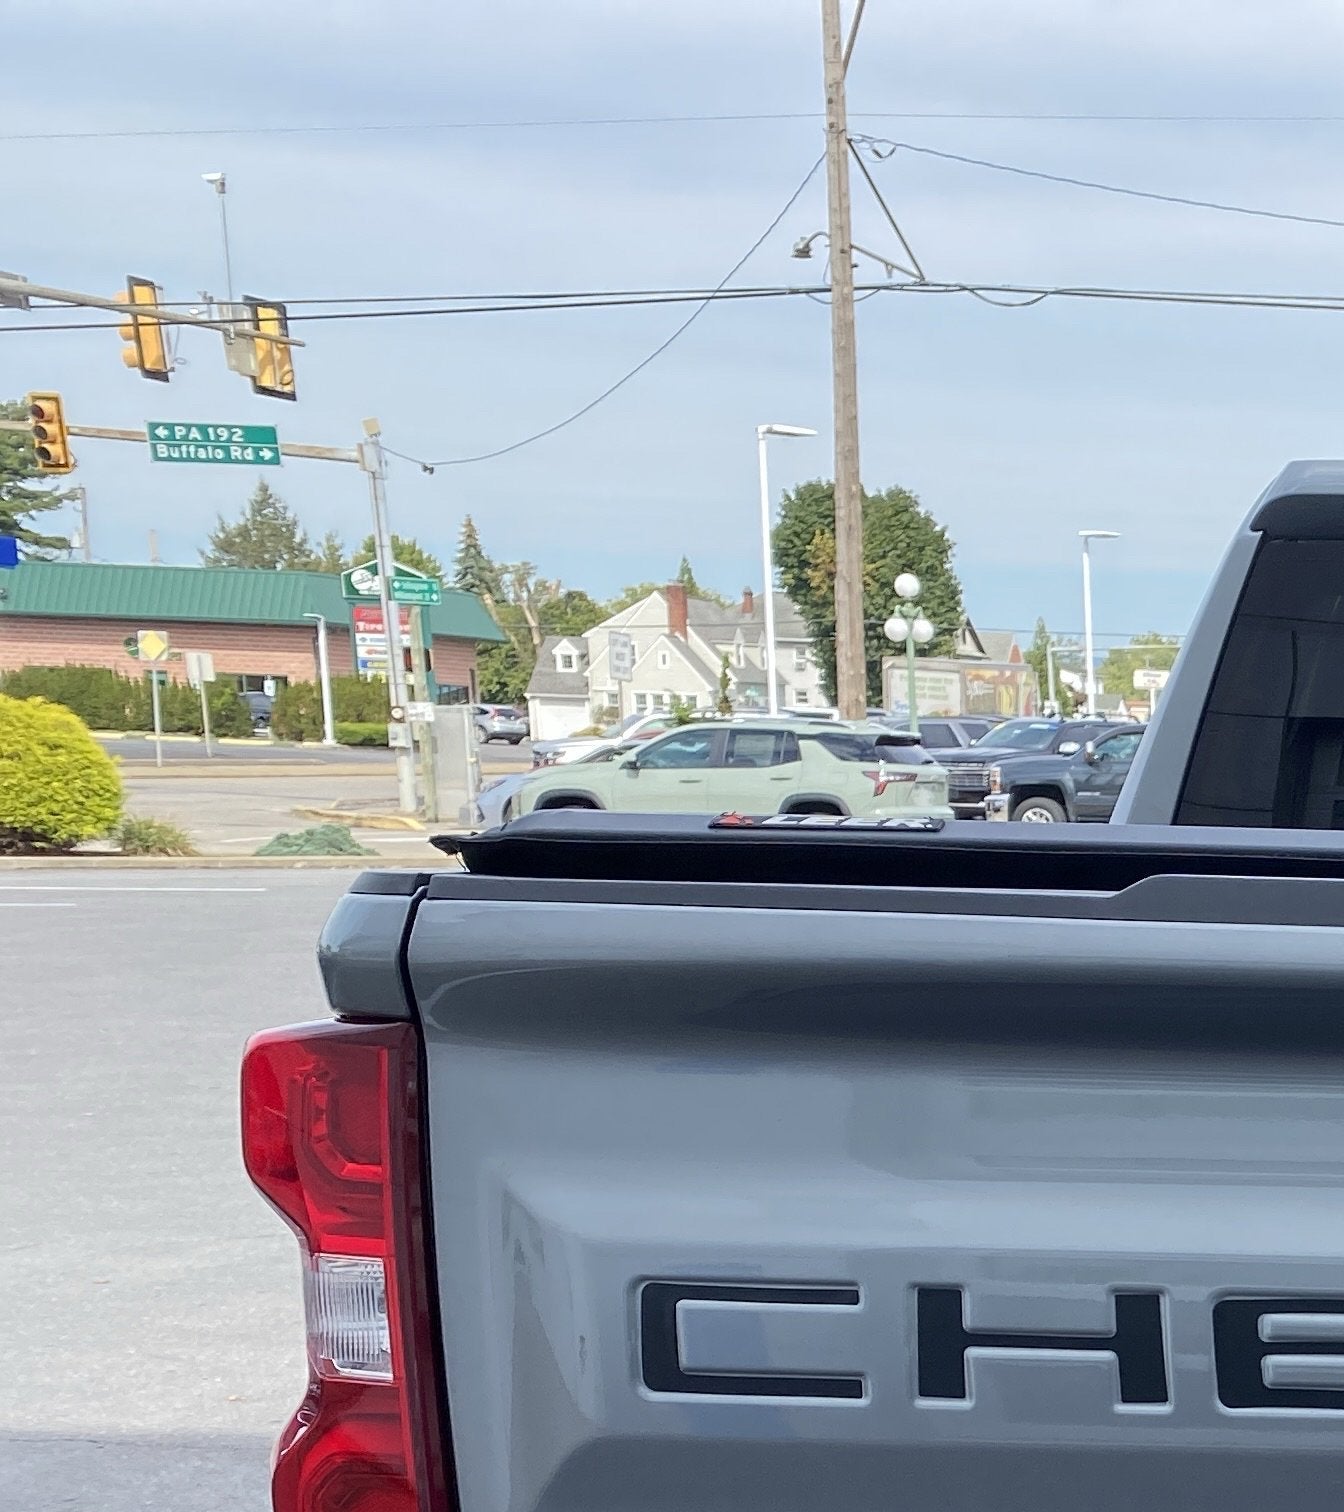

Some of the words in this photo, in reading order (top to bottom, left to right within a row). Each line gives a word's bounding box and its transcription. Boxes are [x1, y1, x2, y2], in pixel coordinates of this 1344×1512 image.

[174, 425, 202, 440] PA
[207, 427, 244, 442] 192
[156, 444, 225, 459] Buffalo
[229, 446, 254, 460] Rd
